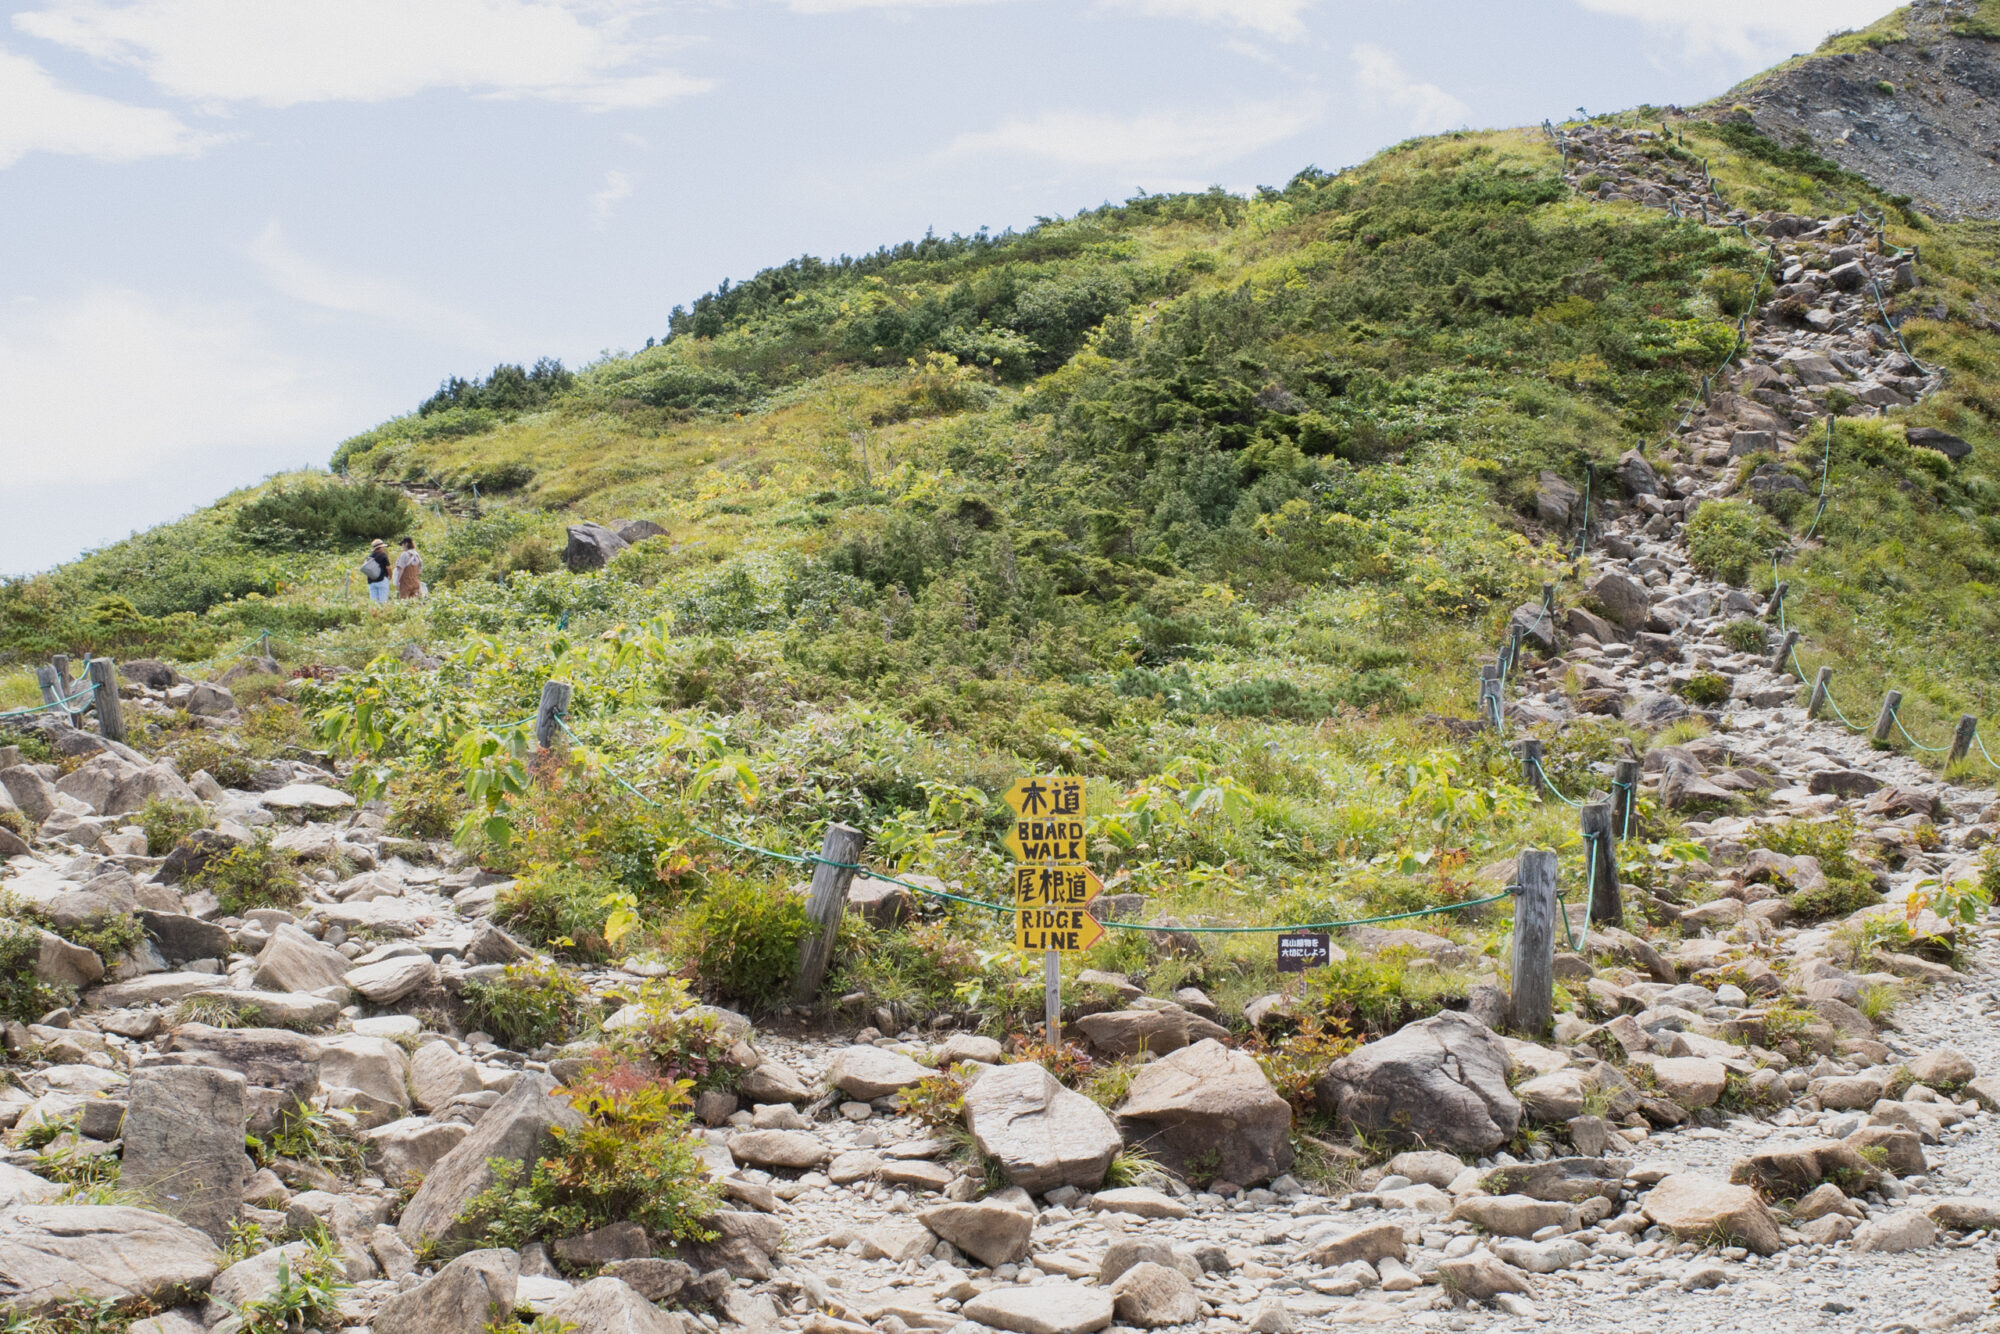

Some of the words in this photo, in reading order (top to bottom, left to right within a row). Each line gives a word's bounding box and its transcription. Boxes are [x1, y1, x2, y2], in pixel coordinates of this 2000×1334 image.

[1021, 780, 1081, 815] 木道
[1018, 822, 1083, 840] BOARD
[1022, 841, 1081, 860] WALK
[1017, 868, 1087, 904] 尾根道
[1021, 910, 1084, 929] RIDGE
[1024, 931, 1081, 950] LINE
